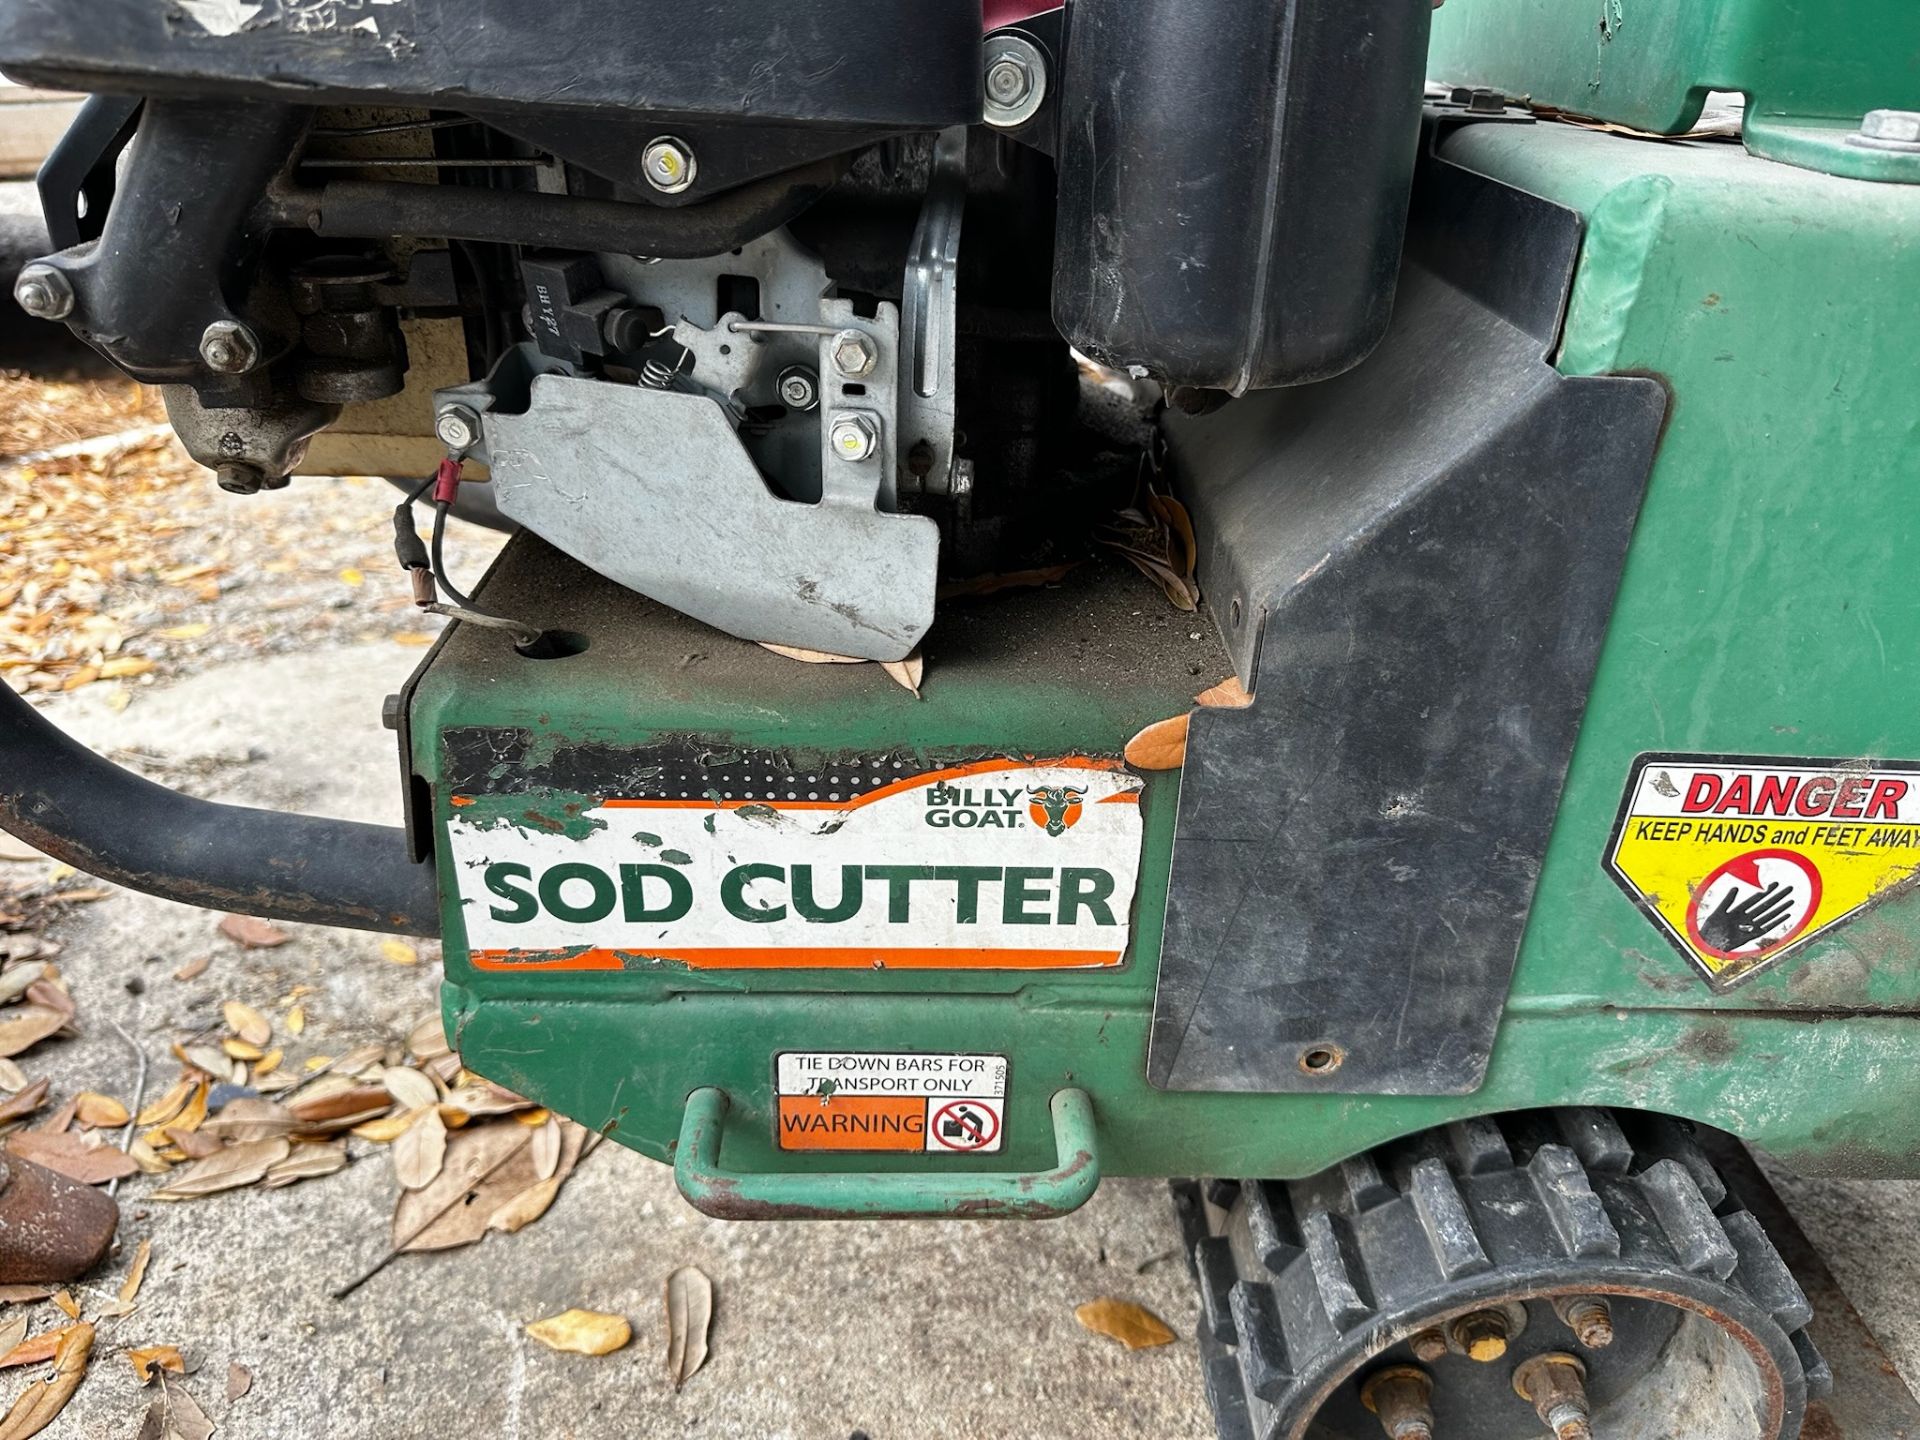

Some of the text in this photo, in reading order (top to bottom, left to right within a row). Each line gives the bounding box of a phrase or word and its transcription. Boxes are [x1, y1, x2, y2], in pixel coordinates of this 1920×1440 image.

[926, 788, 1024, 807] BILLY
[1681, 773, 1908, 820] DANGER
[1636, 821, 1920, 849] KEEP HANDS and FEET AWAY
[483, 863, 1117, 926] SOD CUTTER
[796, 1057, 985, 1072] TIE DOWN BARS FOR
[923, 1078, 973, 1092] ONLY
[993, 1065, 1006, 1096] 371505
[783, 1114, 924, 1133] WARNING
